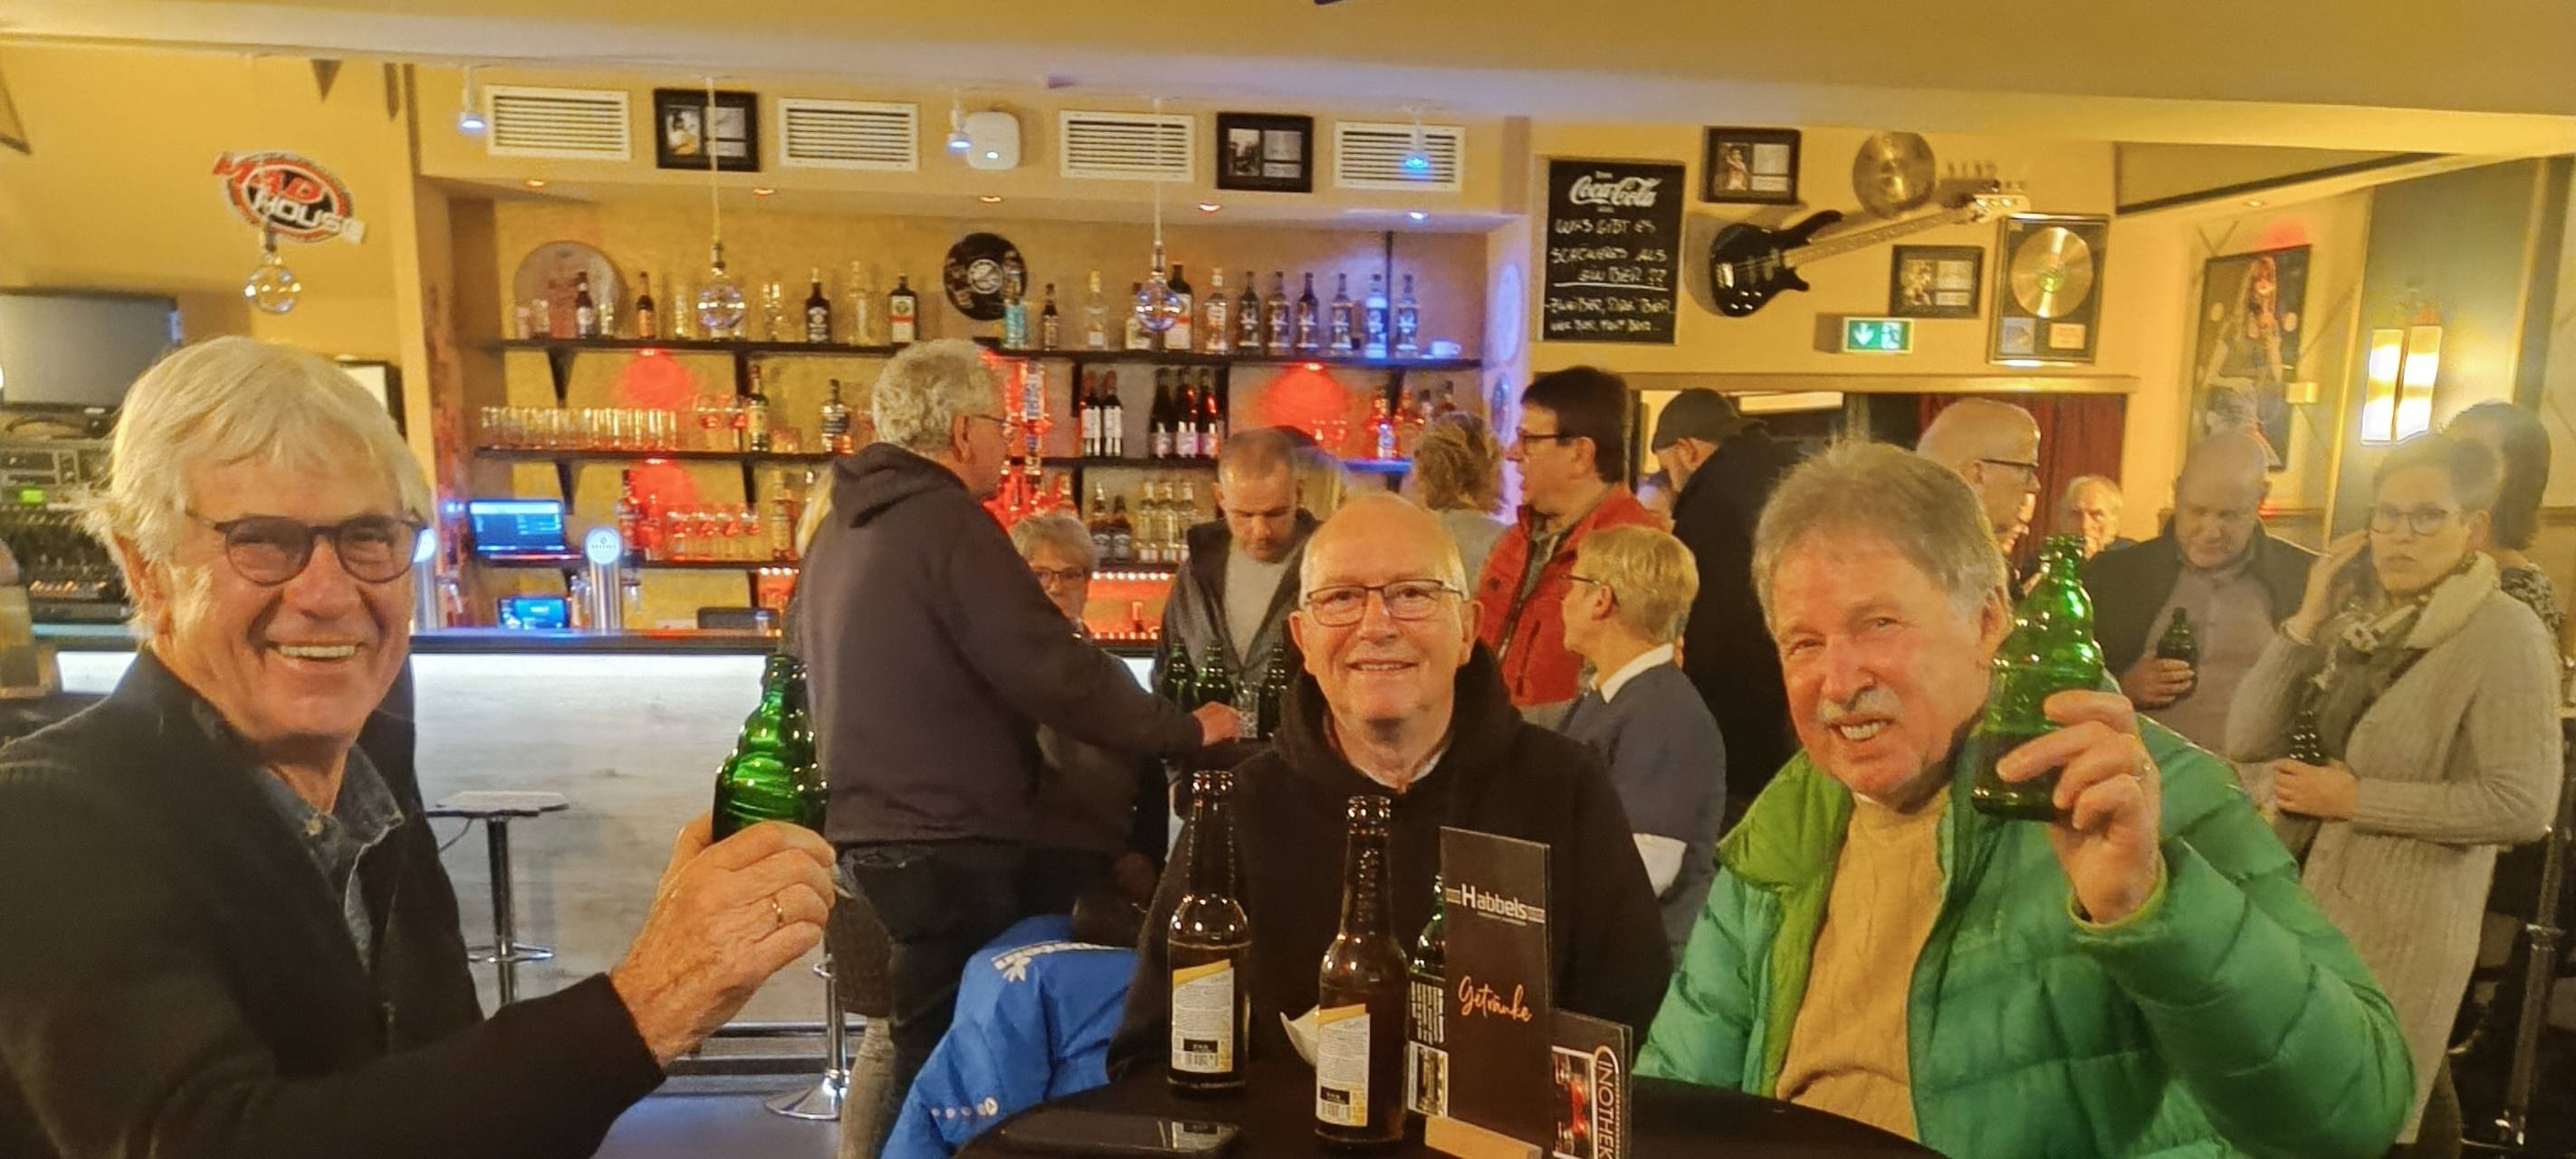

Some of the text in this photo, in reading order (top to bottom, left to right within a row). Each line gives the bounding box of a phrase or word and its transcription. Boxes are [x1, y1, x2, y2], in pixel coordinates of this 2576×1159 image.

[212, 150, 322, 203] MAD
[254, 186, 366, 244] HOUSE
[1461, 882, 1528, 920] Habbels
